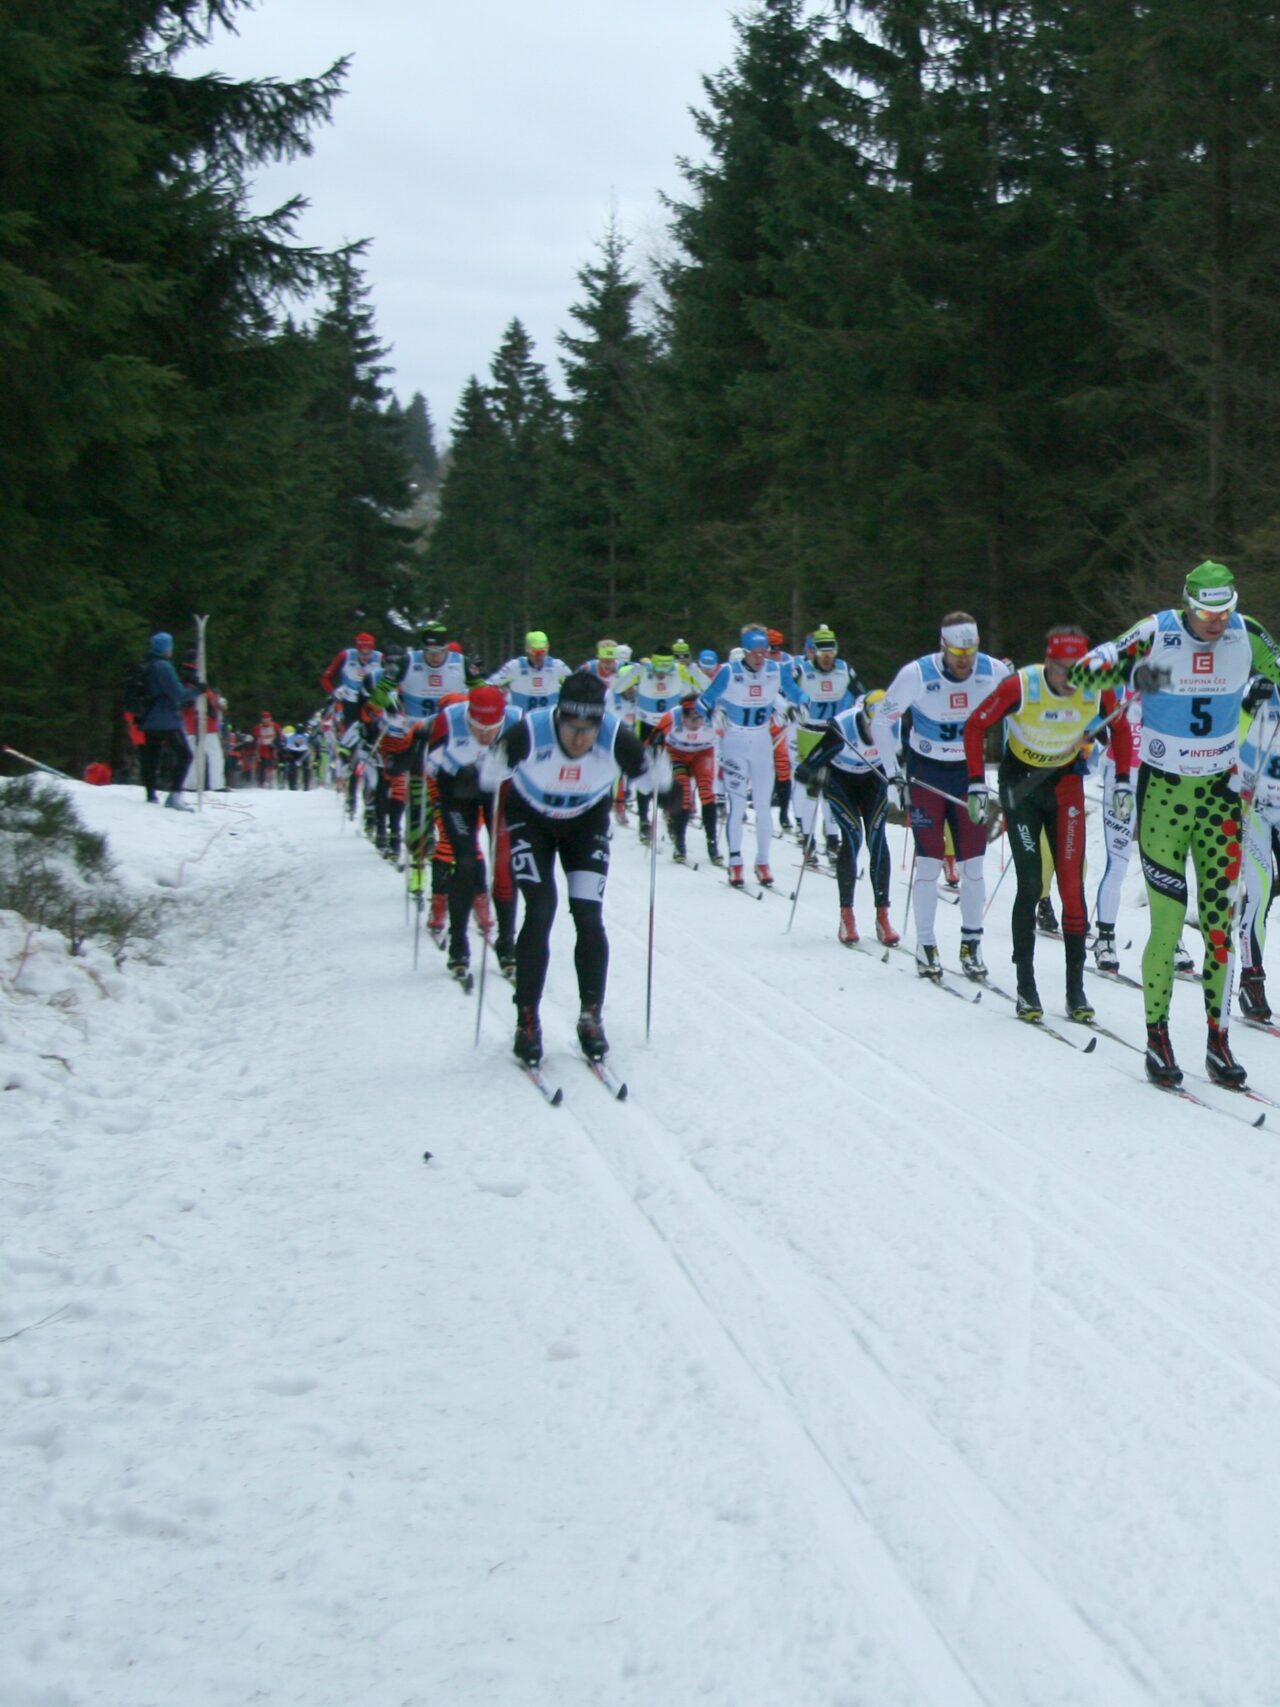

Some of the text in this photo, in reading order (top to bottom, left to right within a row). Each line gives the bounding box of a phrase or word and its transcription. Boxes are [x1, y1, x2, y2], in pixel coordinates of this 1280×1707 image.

[742, 707, 767, 727] 16
[816, 702, 837, 720] 71
[1190, 697, 1213, 737] 5
[940, 723, 965, 742] 9
